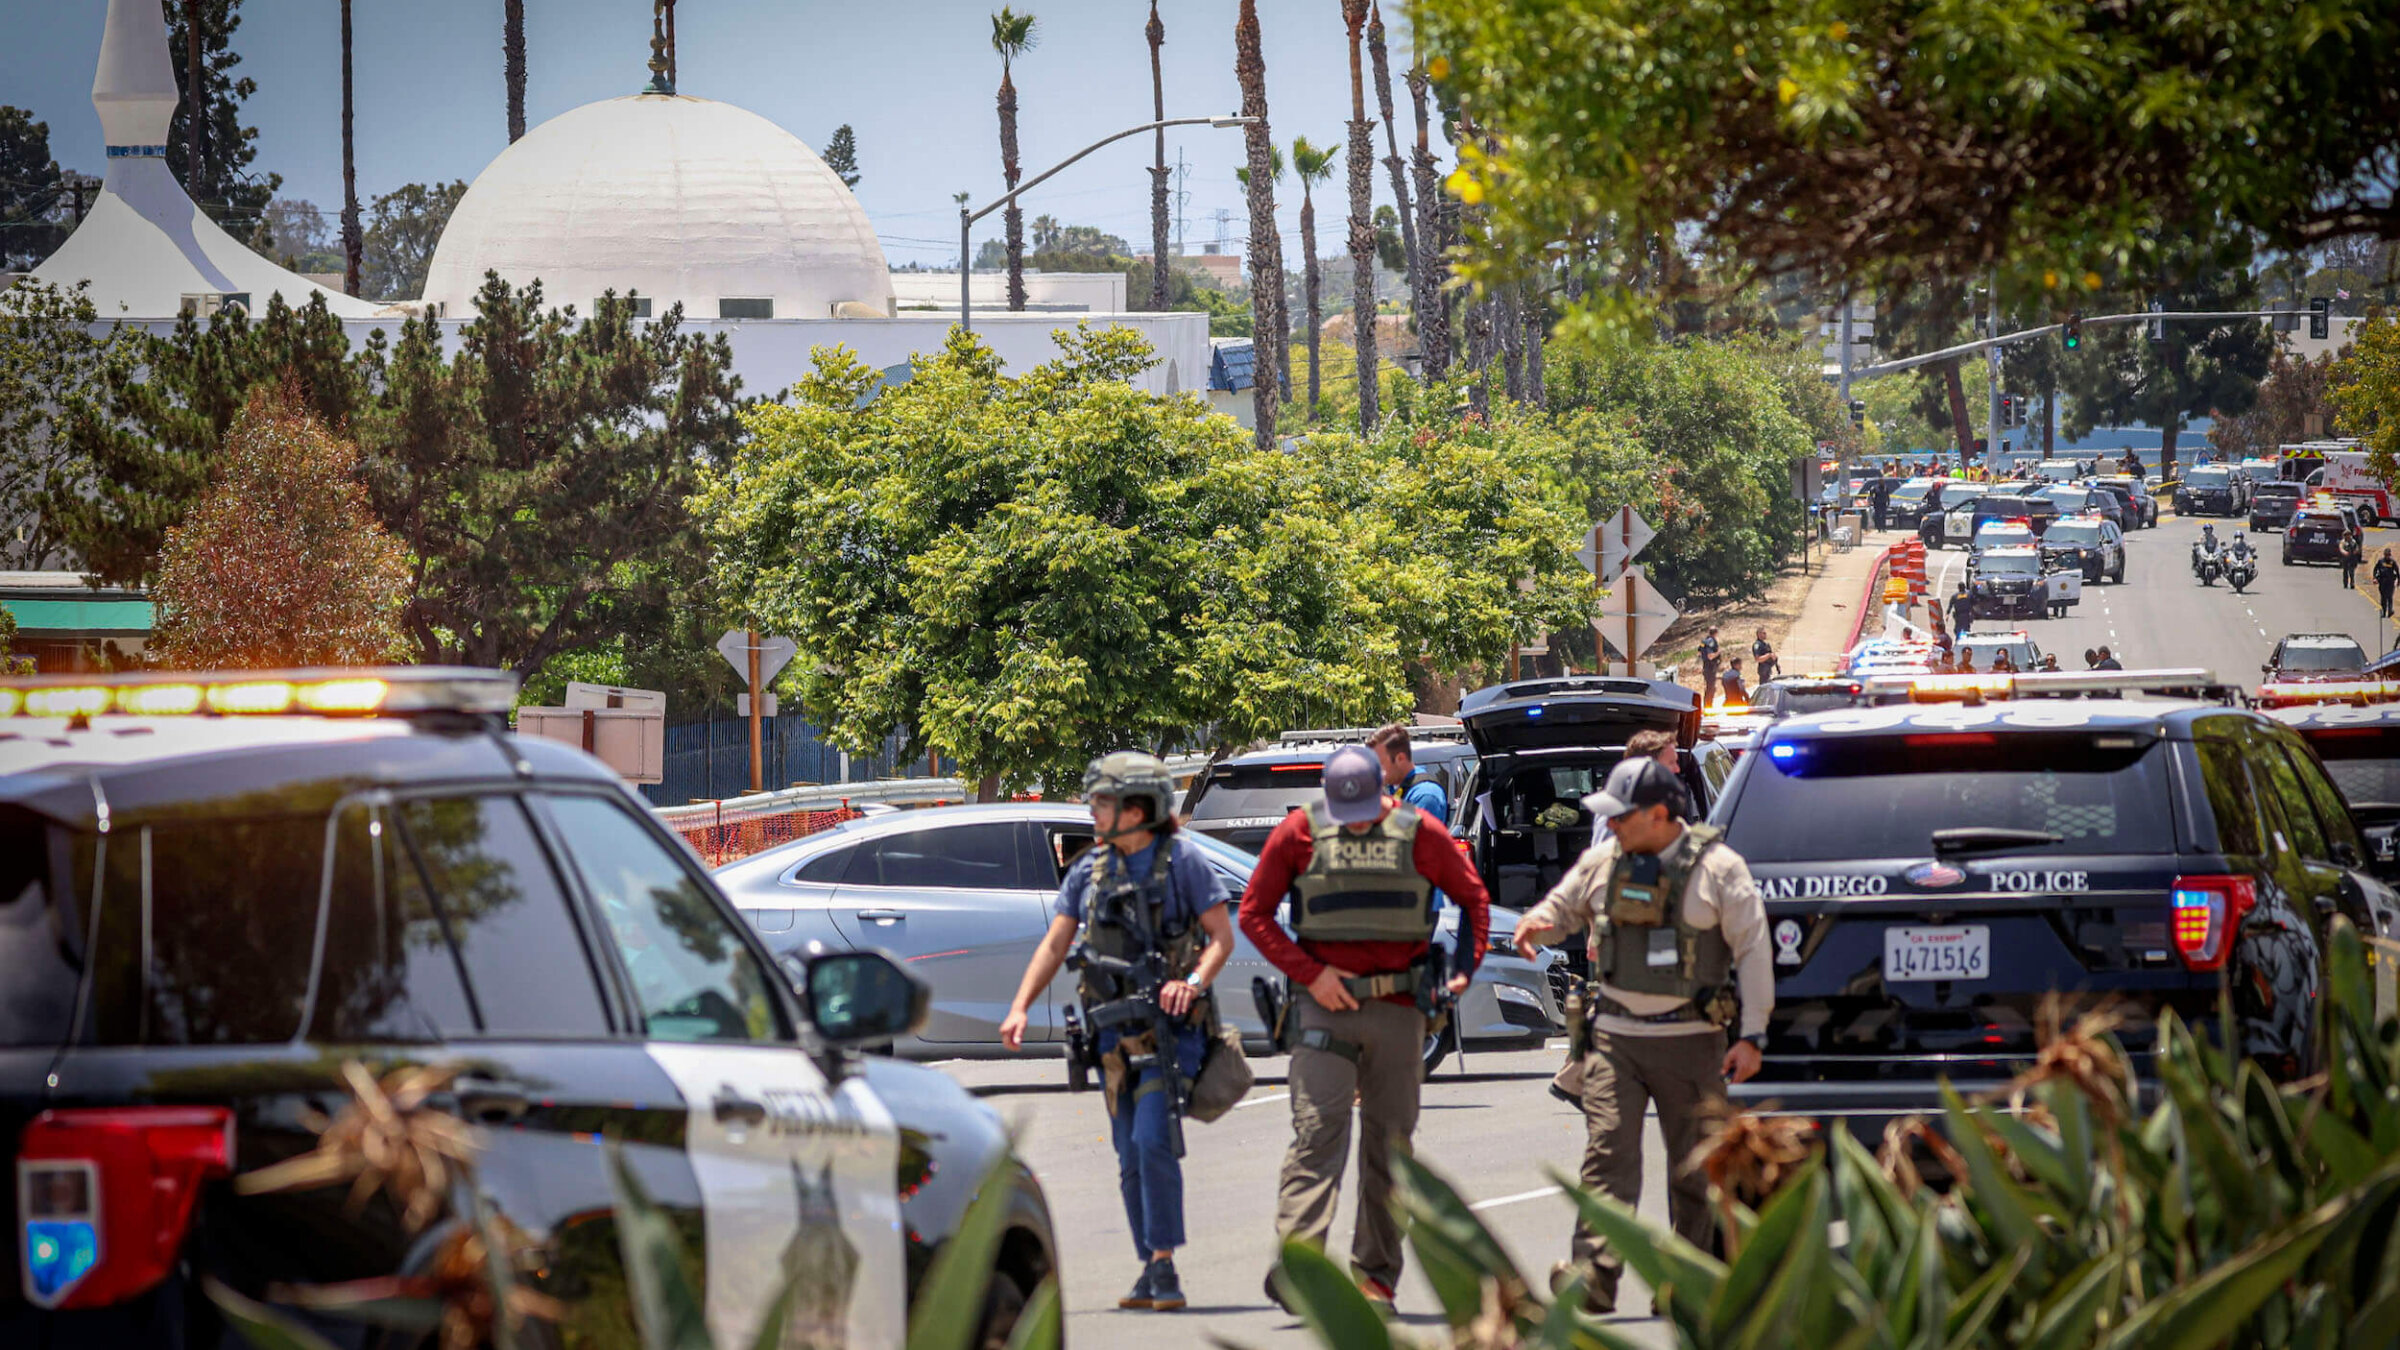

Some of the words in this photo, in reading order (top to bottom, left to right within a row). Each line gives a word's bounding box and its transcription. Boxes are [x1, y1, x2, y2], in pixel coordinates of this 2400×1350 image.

[1226, 818, 1253, 828] SAN
[1254, 817, 1282, 826] DIE
[1329, 841, 1398, 860] POLICE
[1754, 877, 1798, 899] SAN
[1803, 875, 1888, 897] DIEGO
[1990, 870, 2090, 892] POLICE
[1910, 935, 1924, 944] CA
[1927, 933, 1964, 943] EXEMPT
[1893, 945, 1982, 973] 1471516
